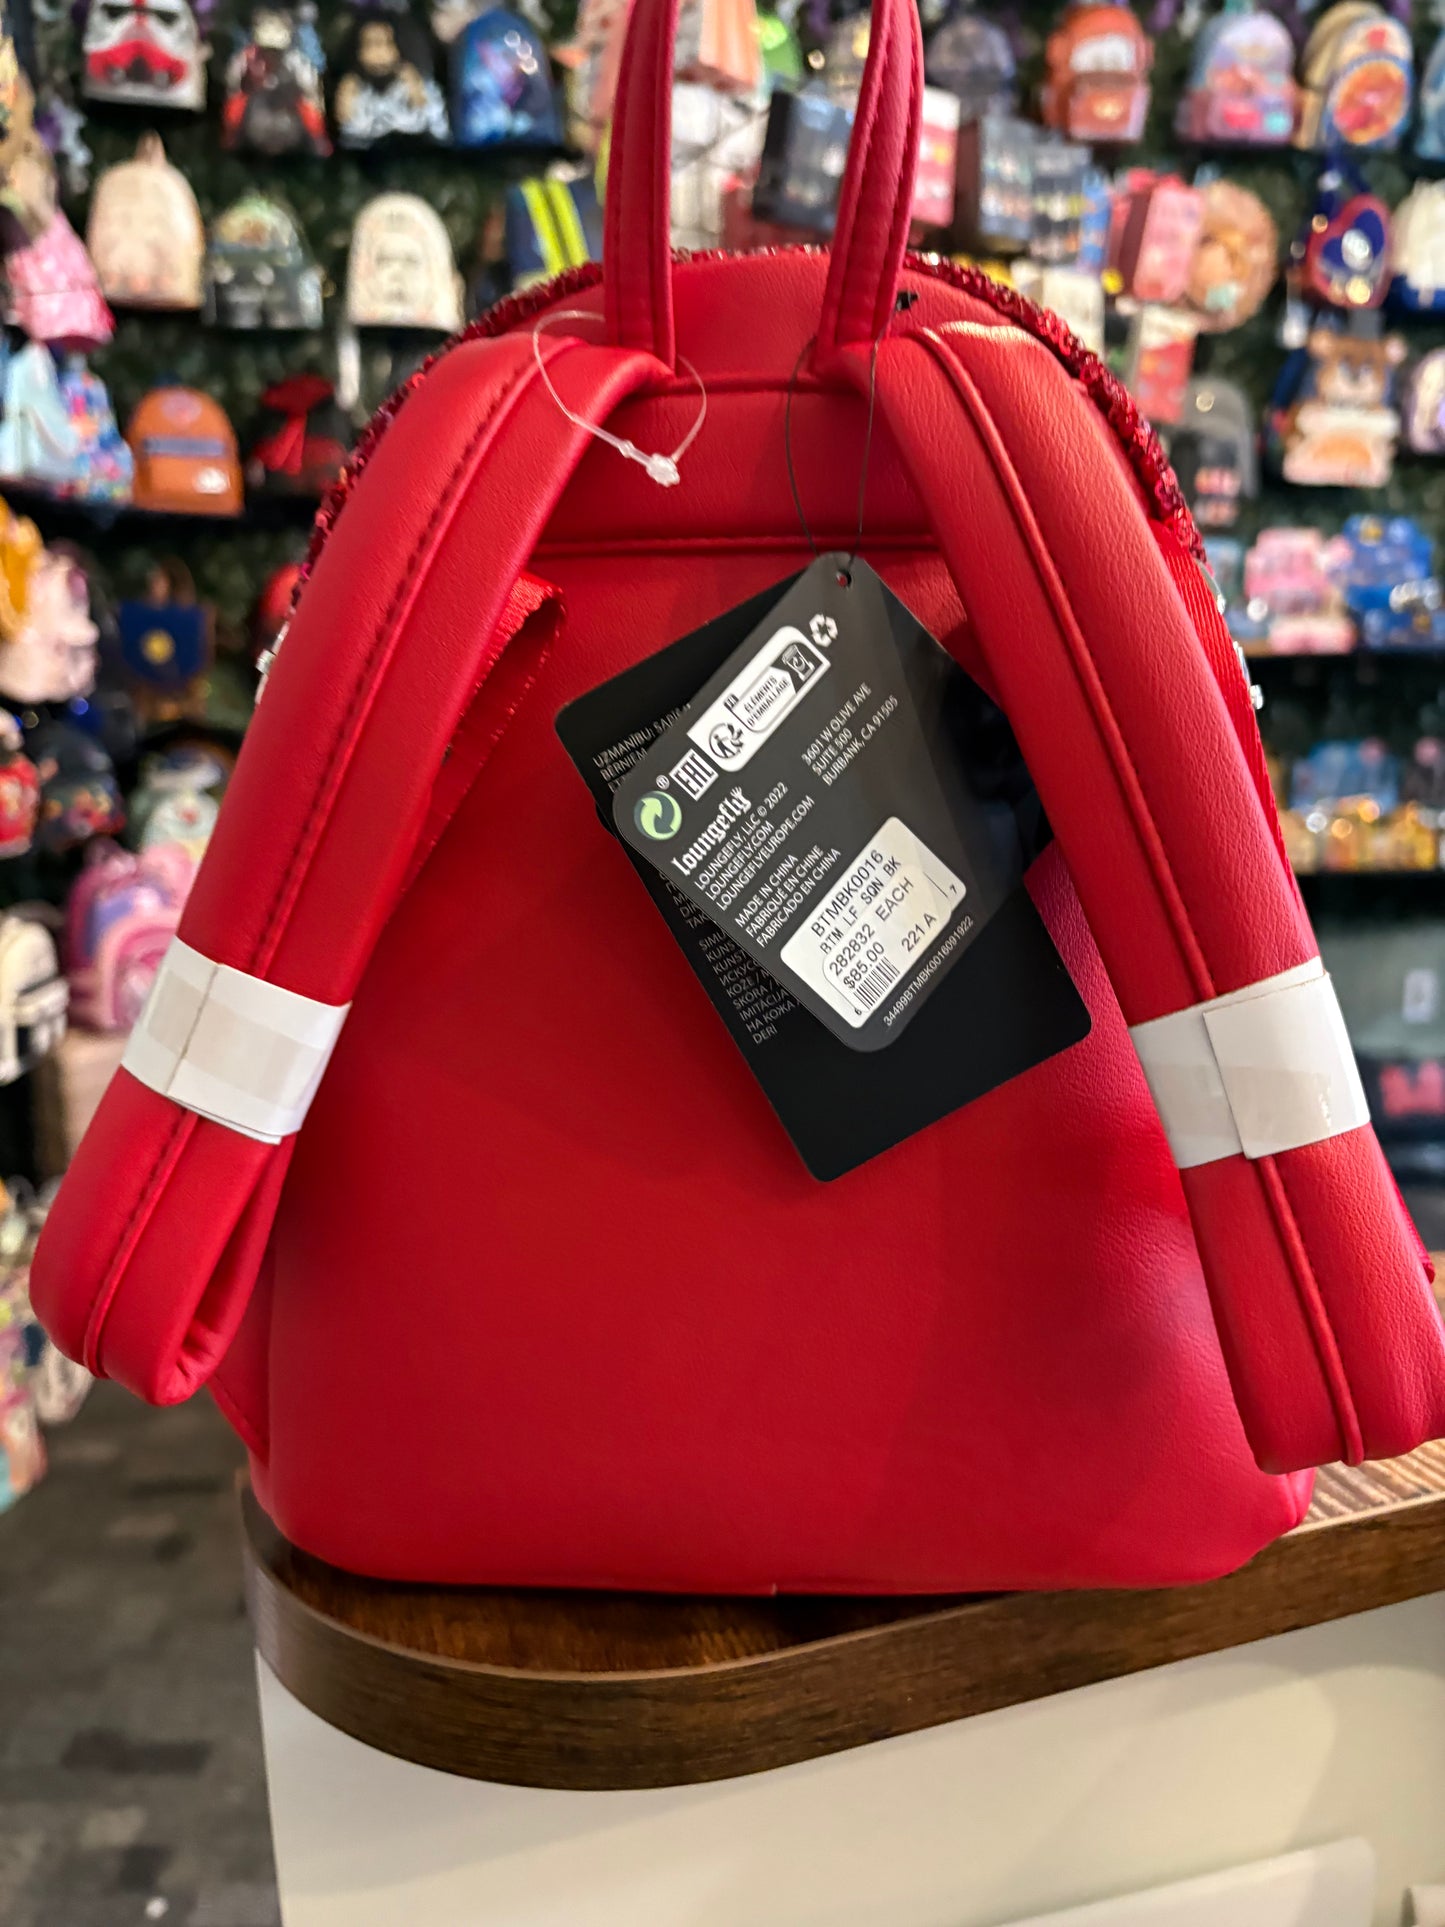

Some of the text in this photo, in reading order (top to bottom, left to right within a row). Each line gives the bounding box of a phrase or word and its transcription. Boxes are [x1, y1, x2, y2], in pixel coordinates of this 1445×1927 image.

[801, 682, 871, 765] 3601 W OLIVE AVE
[811, 727, 852, 775] SUITE 500
[821, 695, 898, 785] BURBANK, CA 91505
[672, 751, 717, 796] EAC
[672, 787, 751, 875] loungefly
[694, 831, 746, 890] LOUNGEFLY,
[740, 812, 761, 835] LLC
[763, 781, 788, 809] 2022
[705, 820, 774, 900] LOUNGEFLY.COM
[716, 795, 814, 910] LOUNGEFLYEUROPE.COM
[734, 854, 798, 927] MADE IN CHINA
[743, 844, 823, 937] FABRIQUÉ EN CHINE
[755, 848, 840, 947] FABRICADO EN CHINA
[810, 849, 883, 936] BTMBK0016
[819, 855, 901, 954] BTM LF SQN BK
[828, 876, 913, 976] 282832 EACH
[900, 912, 936, 952] 221 A
[842, 941, 884, 989] $85.00
